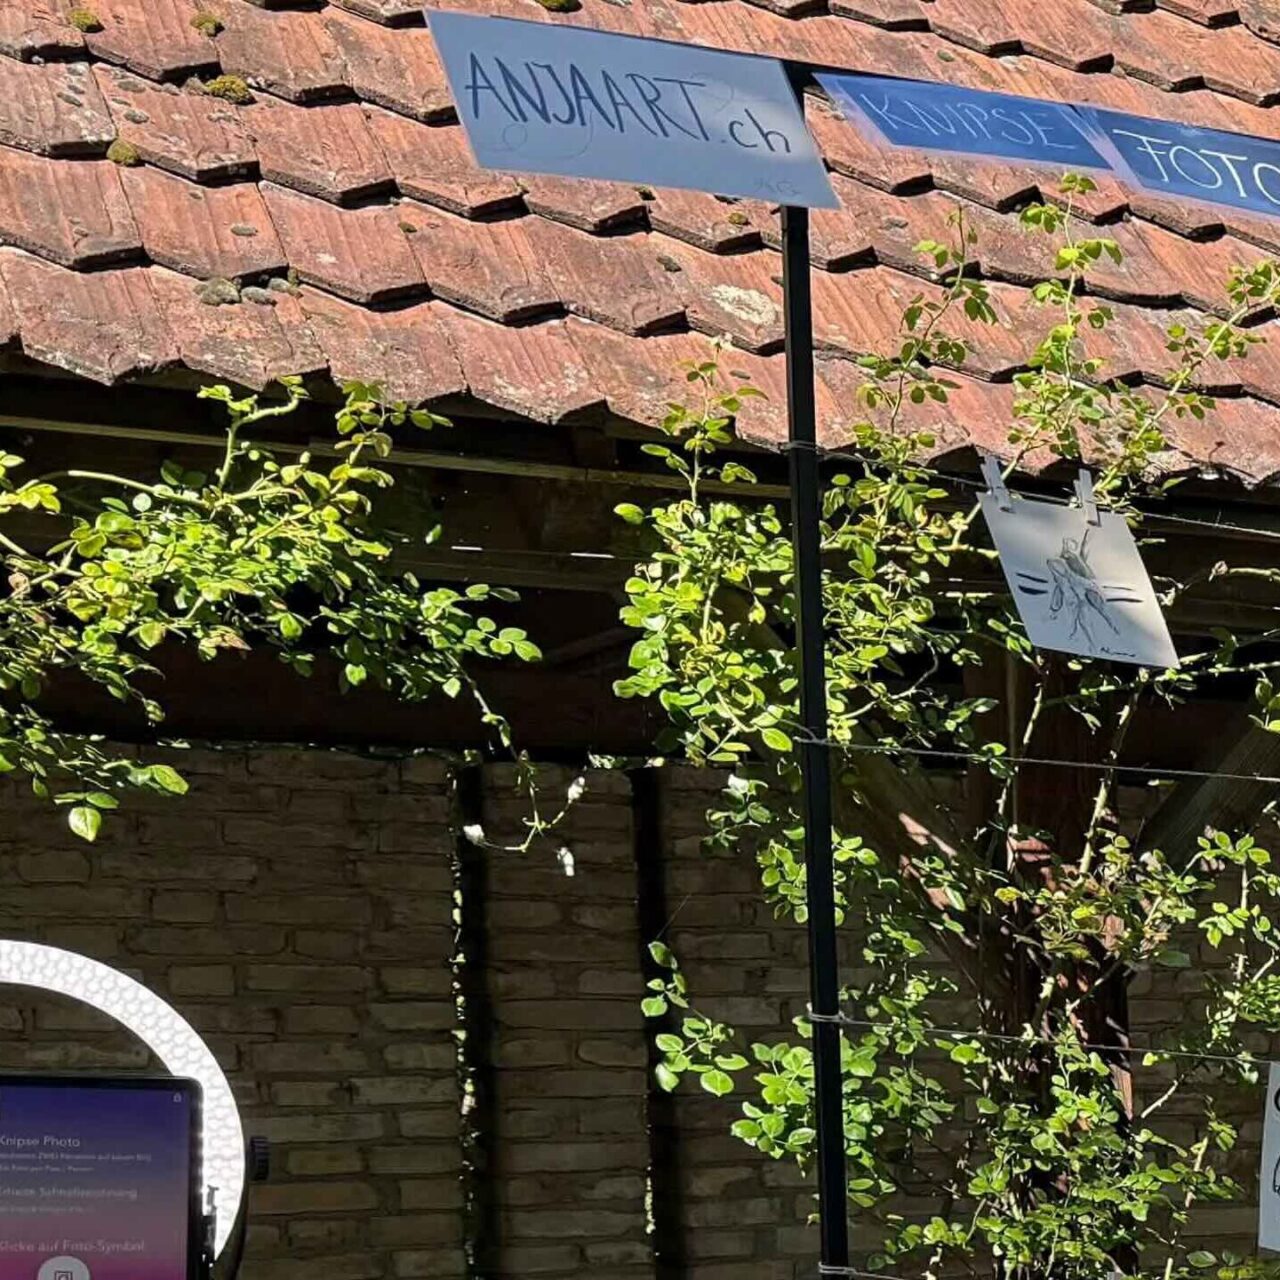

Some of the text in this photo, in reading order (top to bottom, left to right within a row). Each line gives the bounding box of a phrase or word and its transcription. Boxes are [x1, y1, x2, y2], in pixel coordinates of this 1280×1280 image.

[464, 51, 792, 154] ANJAART.ch
[859, 93, 1077, 150] KNIPSE
[43, 1134, 81, 1148] Photo
